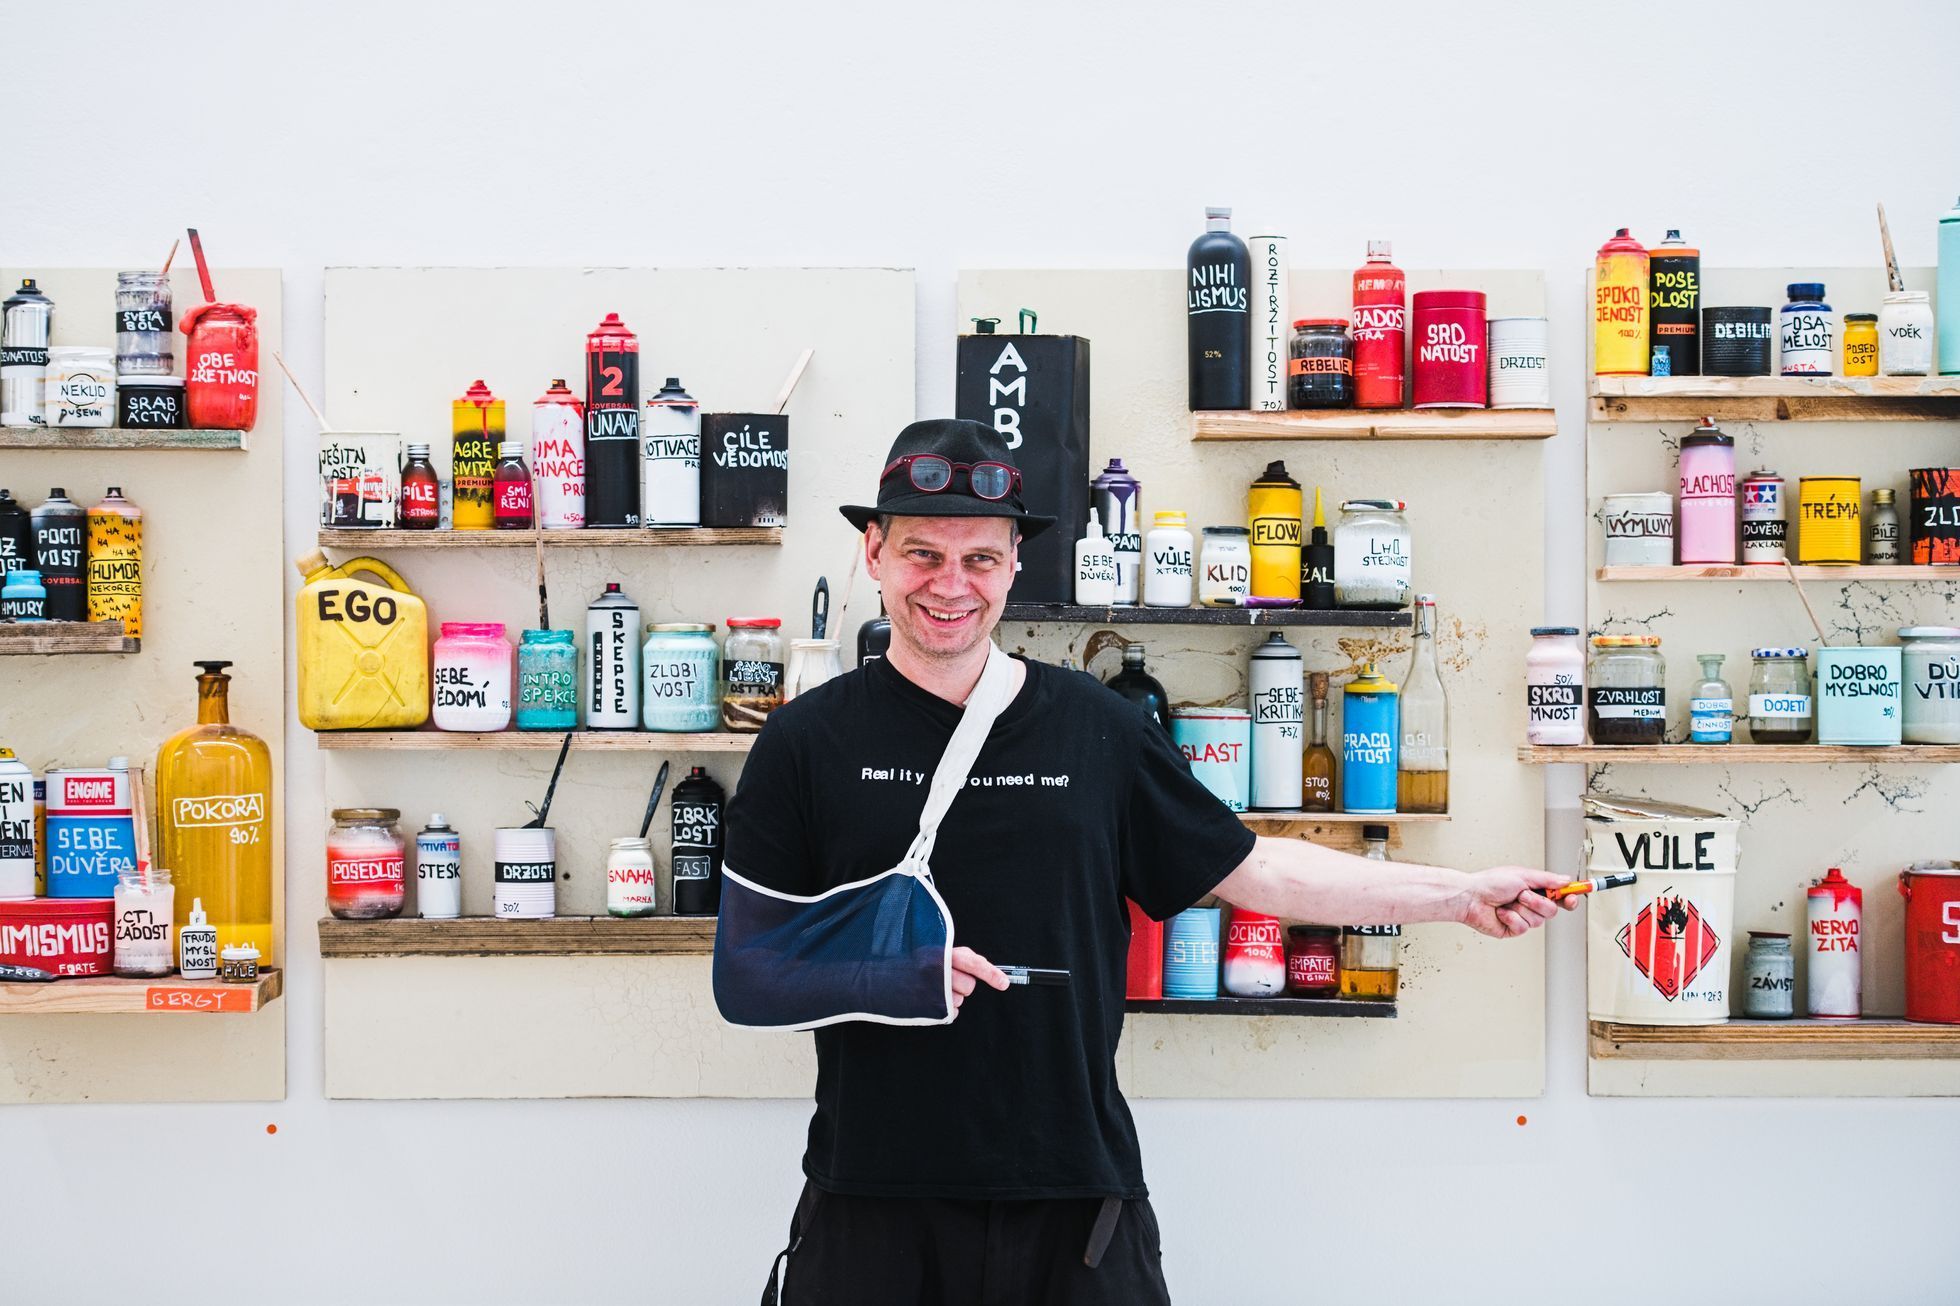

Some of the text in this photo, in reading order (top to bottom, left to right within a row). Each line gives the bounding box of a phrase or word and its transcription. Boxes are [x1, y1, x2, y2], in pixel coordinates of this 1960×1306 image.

[1192, 263, 1236, 287] NIHI
[1655, 271, 1699, 290] POSE
[1188, 286, 1247, 310] LISMUS
[1596, 286, 1641, 306] SPOKO
[122, 310, 164, 326] SVĚTA
[1596, 305, 1644, 324] JENOST
[1792, 315, 1827, 331] OSA
[126, 321, 160, 333] BOL
[1427, 322, 1466, 346] SRD
[1889, 323, 1922, 339] VDĚK
[198, 352, 236, 372] OBE
[1420, 344, 1479, 364] NATOST
[1500, 356, 1547, 370] DRZOST
[1846, 354, 1875, 365] LOST
[1300, 358, 1350, 374] REBELIE
[601, 366, 624, 396] 2
[60, 384, 107, 398] NEKLID
[989, 341, 1028, 451] AMB
[127, 396, 177, 411] SRAB
[1261, 399, 1284, 410] 70%
[722, 424, 772, 450] CÍLE
[453, 440, 493, 460] AGRE
[402, 481, 436, 503] PÍLE
[506, 483, 528, 498] SMÍ
[1801, 493, 1860, 520] TRÉMA
[38, 528, 81, 545] POCTI
[1256, 523, 1301, 542] FLOW
[1743, 521, 1785, 536] DŮVĚRA
[37, 548, 82, 568] VOST
[1081, 554, 1114, 567] SEBE
[1153, 546, 1192, 567] VŮLE
[92, 562, 141, 581] HUMOR
[1207, 563, 1248, 583] KLID
[1300, 562, 1335, 583] ŽAL
[317, 589, 398, 626] EGO
[611, 611, 628, 714] SKEPSE
[650, 662, 698, 679] ZLOBI
[435, 666, 474, 686] SEBE
[523, 671, 572, 686] INTRO
[594, 641, 602, 711] PREMIUM
[1553, 673, 1573, 685] 50%
[1830, 664, 1888, 680] DOBRO
[434, 680, 490, 708] ĚDOMÍ
[522, 688, 577, 705] SPEKCE
[652, 680, 696, 698] VOST
[1268, 687, 1300, 703] SEBE
[1596, 690, 1661, 704] ZVRHLOST
[1825, 681, 1900, 699] MYSLNOST
[1530, 705, 1578, 721] MNOST
[1763, 695, 1809, 713] DOJETÍ
[1278, 726, 1298, 740] 75%
[996, 773, 1035, 787] need
[1040, 774, 1070, 788] me?
[179, 797, 261, 823] POKORA
[673, 806, 719, 826] ZBRK
[58, 827, 123, 851] SEBE
[229, 826, 260, 845] 90%
[673, 824, 717, 844] LOST
[0, 844, 34, 858] ERNAL
[1614, 831, 1716, 871] VŮLE
[51, 850, 136, 877] DŮVĚRA
[332, 860, 405, 881] POSEDLOST
[418, 863, 461, 880] STESK
[675, 860, 709, 876] FAST
[608, 868, 654, 887] SNAHA
[1811, 919, 1860, 935] NERVO
[0, 922, 110, 957] IMISMUS
[183, 933, 216, 944] TRUDO
[1817, 936, 1858, 953] ZITA
[185, 945, 216, 956] MYSL
[1244, 946, 1273, 960] 100%
[58, 962, 99, 977] FORTE
[185, 957, 216, 968] NOST
[1290, 957, 1334, 973] EMPATIE
[1667, 978, 1675, 989] 3
[1751, 971, 1794, 992] ZÁVIST
